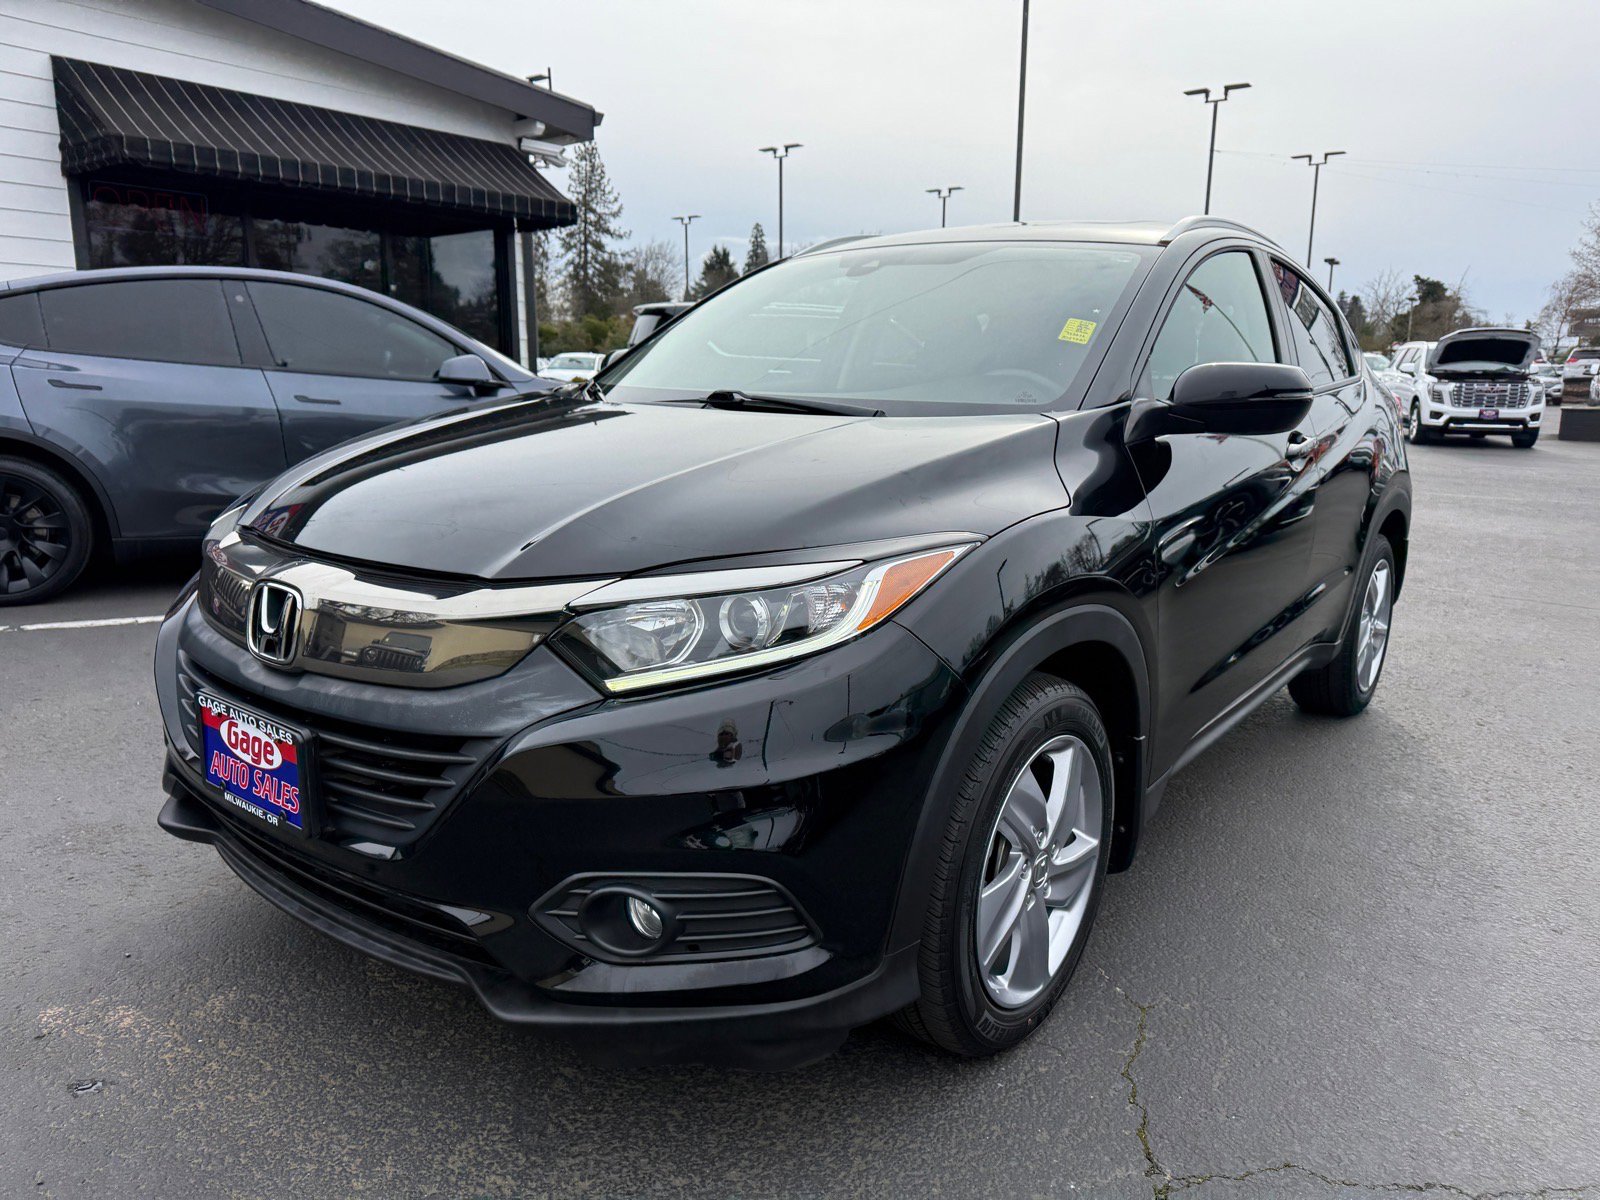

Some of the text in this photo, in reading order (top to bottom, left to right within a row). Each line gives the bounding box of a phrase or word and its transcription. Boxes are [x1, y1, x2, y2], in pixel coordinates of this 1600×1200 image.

[198, 696, 293, 745] GAGE AUTO SALES
[227, 720, 274, 765] Gage
[210, 750, 300, 814] AUTO SALES
[224, 792, 279, 826] MILWAUKIE, OR
